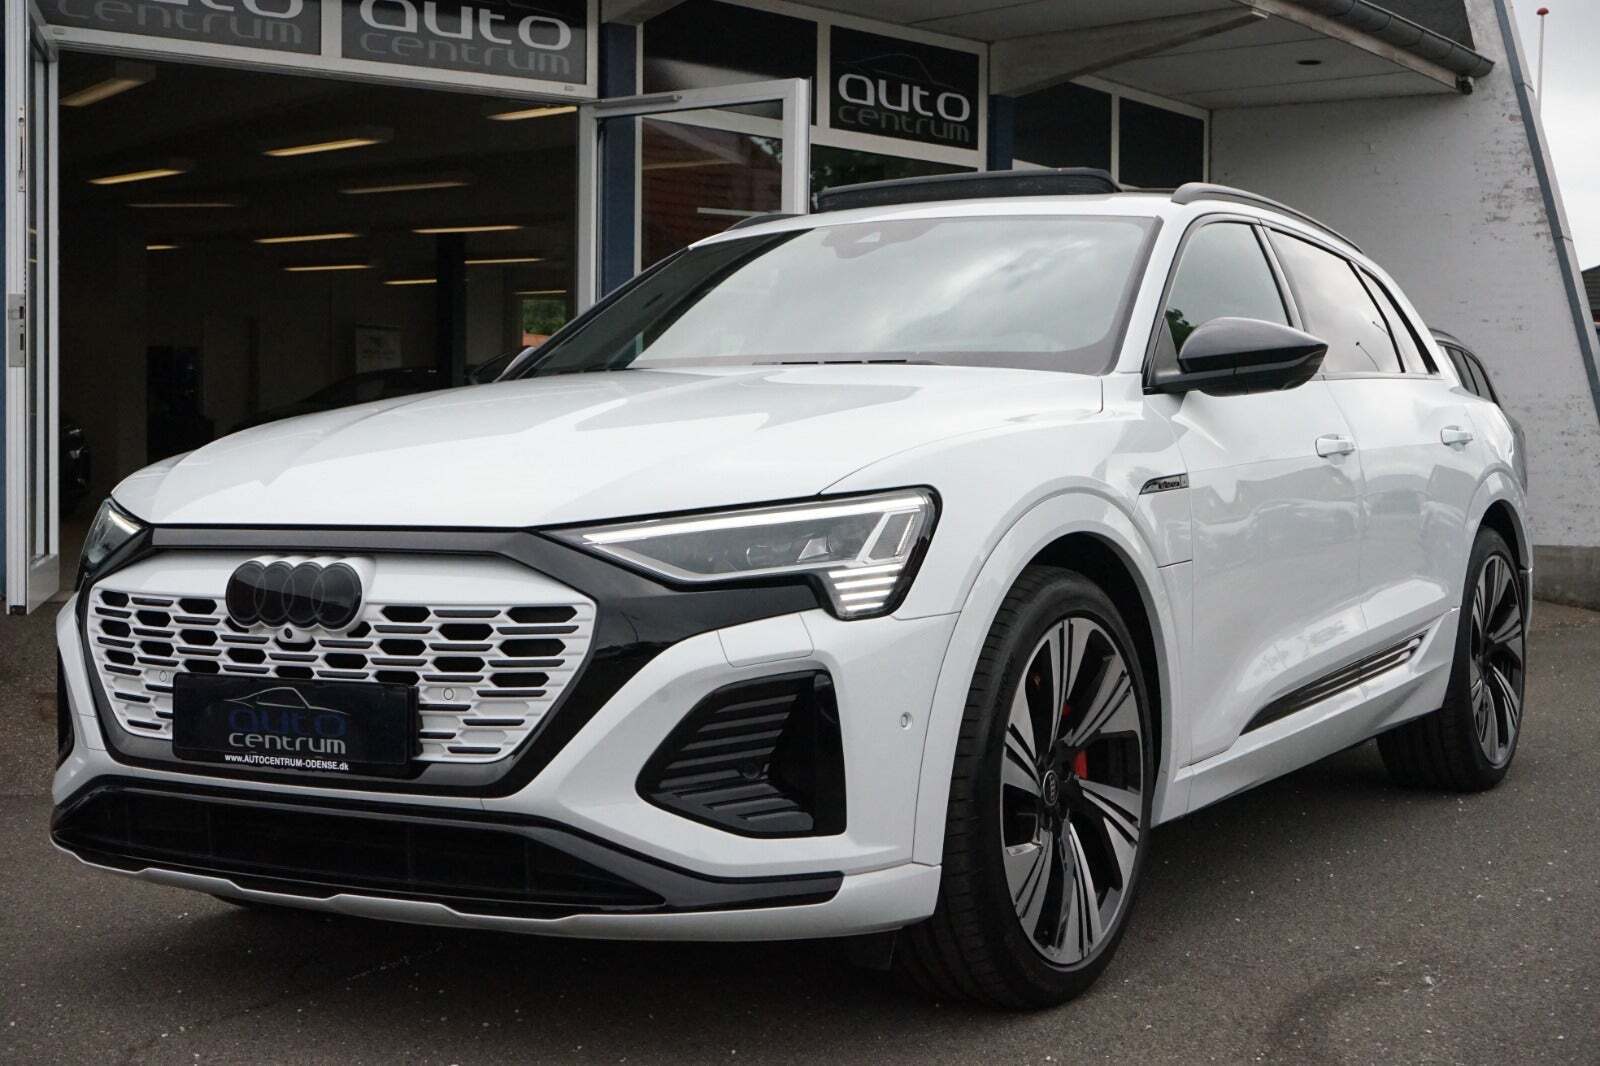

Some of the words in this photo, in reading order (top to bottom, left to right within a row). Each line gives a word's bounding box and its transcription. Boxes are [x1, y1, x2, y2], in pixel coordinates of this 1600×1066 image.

[57, 0, 301, 44] centrum
[359, 0, 572, 51] auto
[359, 32, 571, 75] centrum
[838, 73, 971, 122] auto
[838, 105, 970, 143] centrum
[227, 707, 348, 736] auto
[224, 753, 350, 771] www.AUTOCENTRUM-ODENSE.dk
[228, 732, 347, 755] centrum
